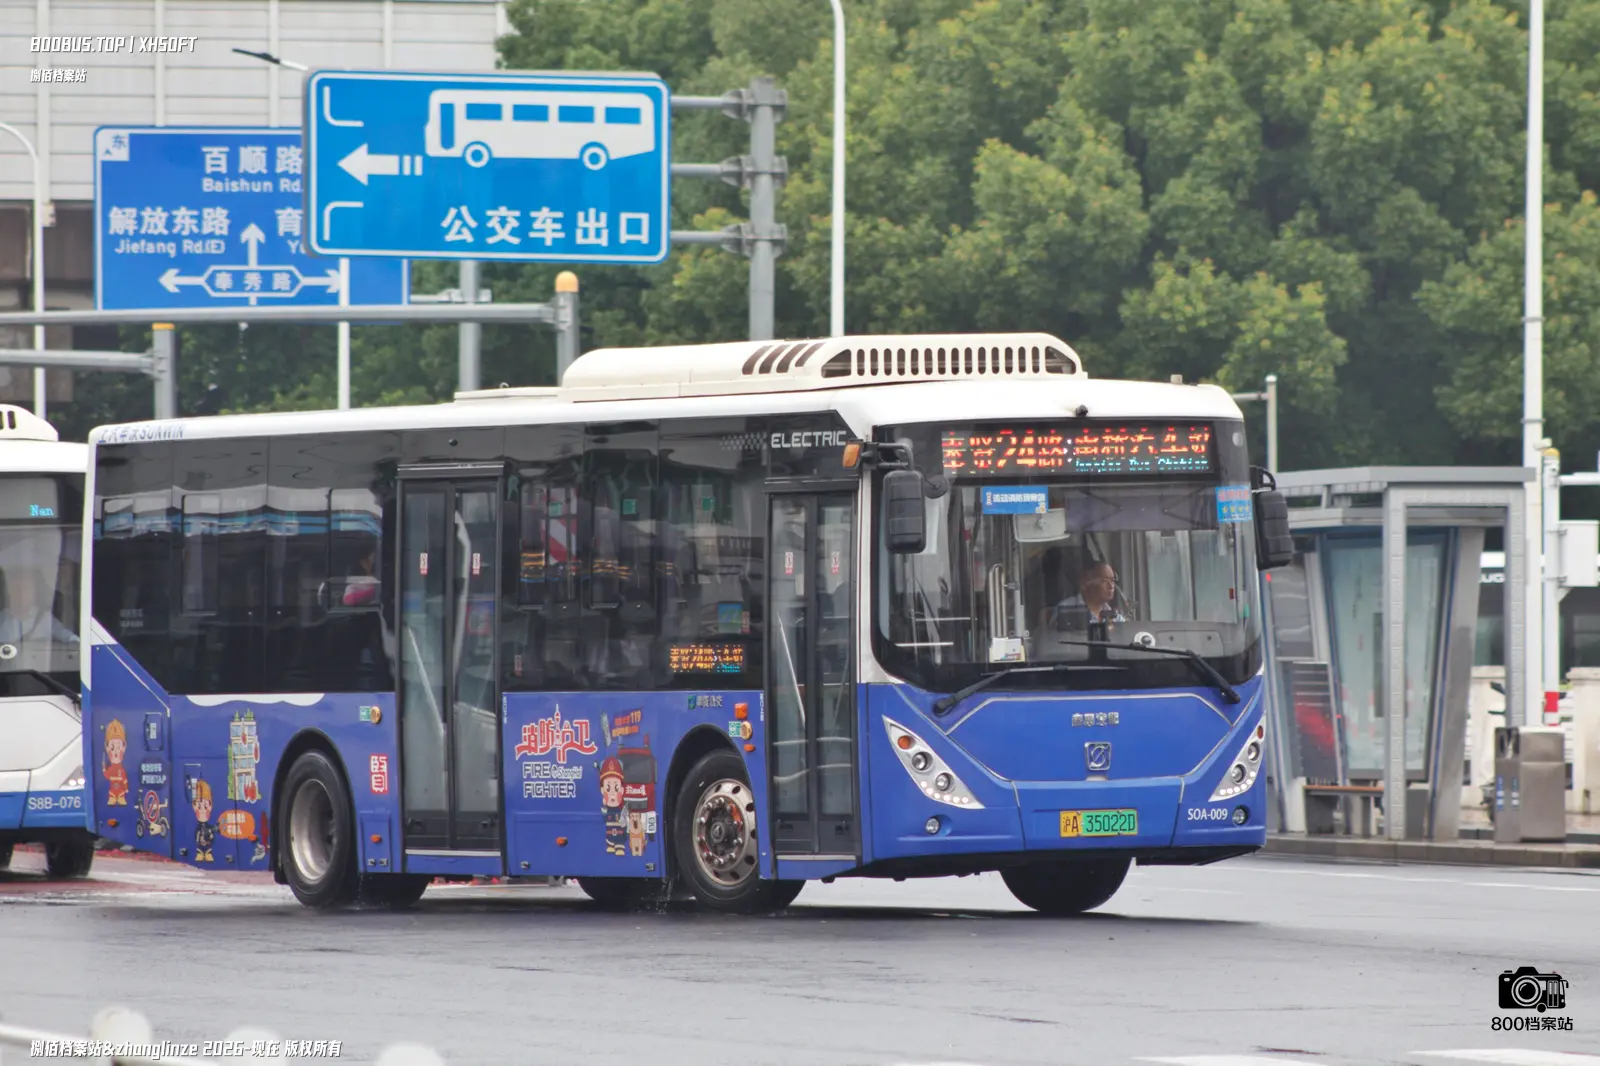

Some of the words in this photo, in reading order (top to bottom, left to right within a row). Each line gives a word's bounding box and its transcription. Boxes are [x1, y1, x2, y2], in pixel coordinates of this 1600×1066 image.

[112, 135, 126, 149] 东
[202, 146, 303, 174] 百顺路
[202, 178, 273, 193] Baishun
[108, 206, 231, 236] 解放东路
[440, 205, 650, 247] 公交车出口
[115, 239, 176, 258] Jiefang
[214, 272, 291, 291] 奉秀路
[771, 430, 847, 449] ELECTRIC
[30, 503, 54, 517] Nan
[523, 761, 551, 779] FIRE
[523, 781, 577, 799] FIGHTER
[28, 796, 82, 810] S8B-076
[1187, 808, 1228, 821] SOA-009
